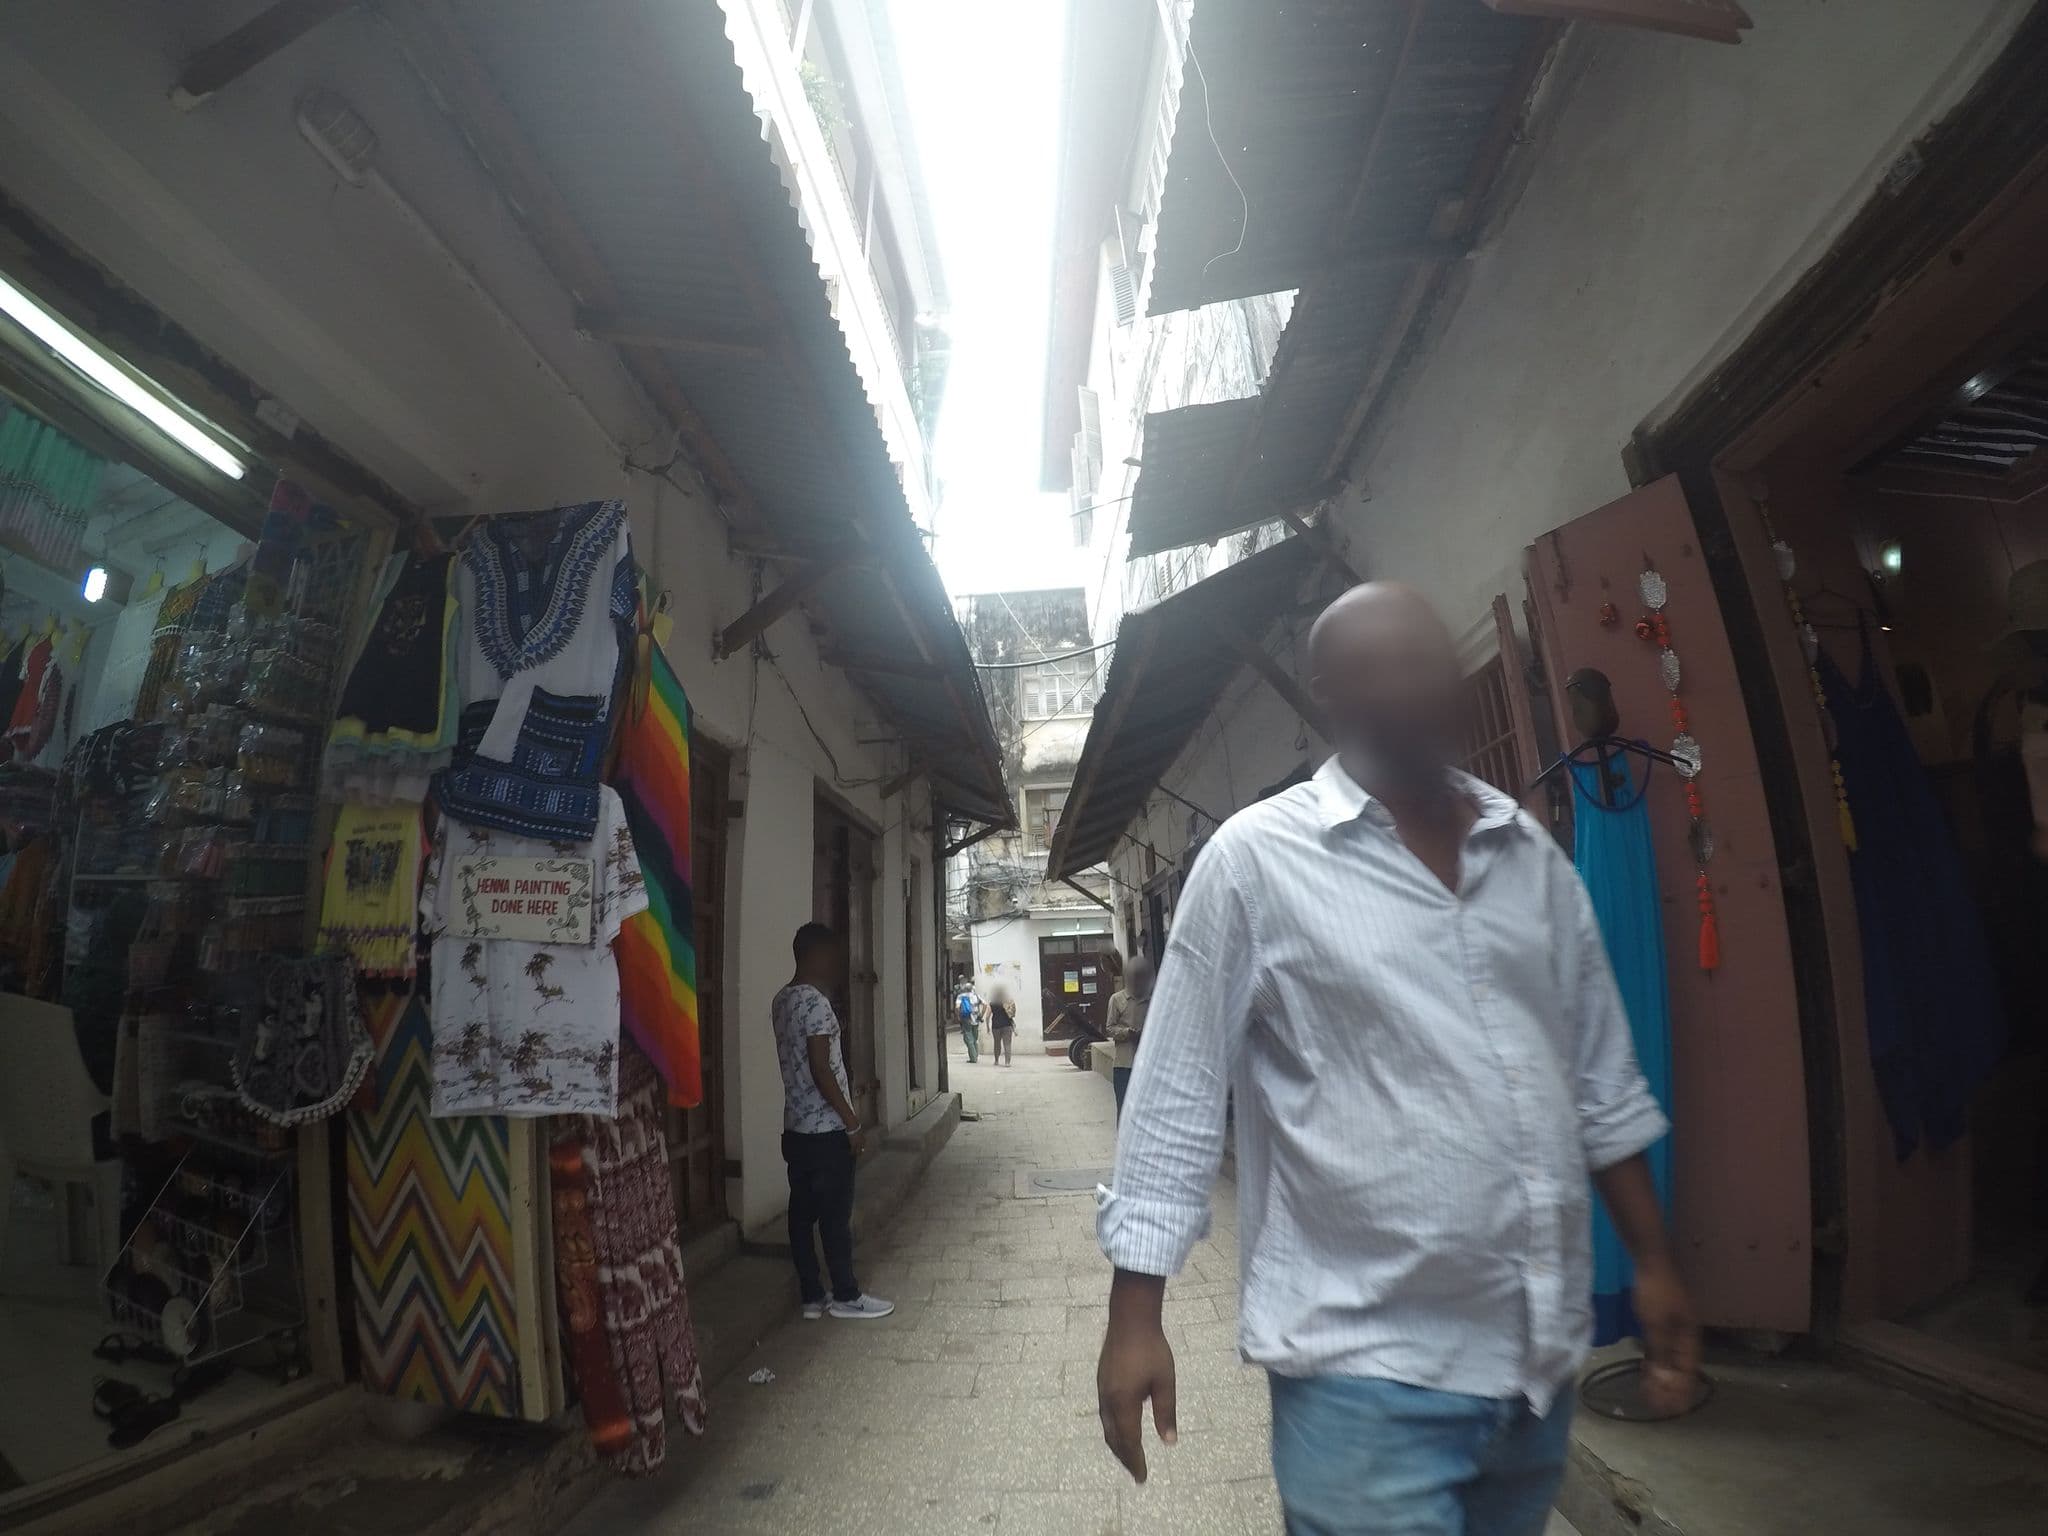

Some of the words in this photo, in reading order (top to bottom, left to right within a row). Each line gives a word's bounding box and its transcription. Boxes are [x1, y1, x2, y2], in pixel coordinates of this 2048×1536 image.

[477, 878, 510, 894] HENNA
[514, 879, 571, 895] PAINTING
[491, 899, 524, 914] DONE
[527, 900, 559, 915] HERE
